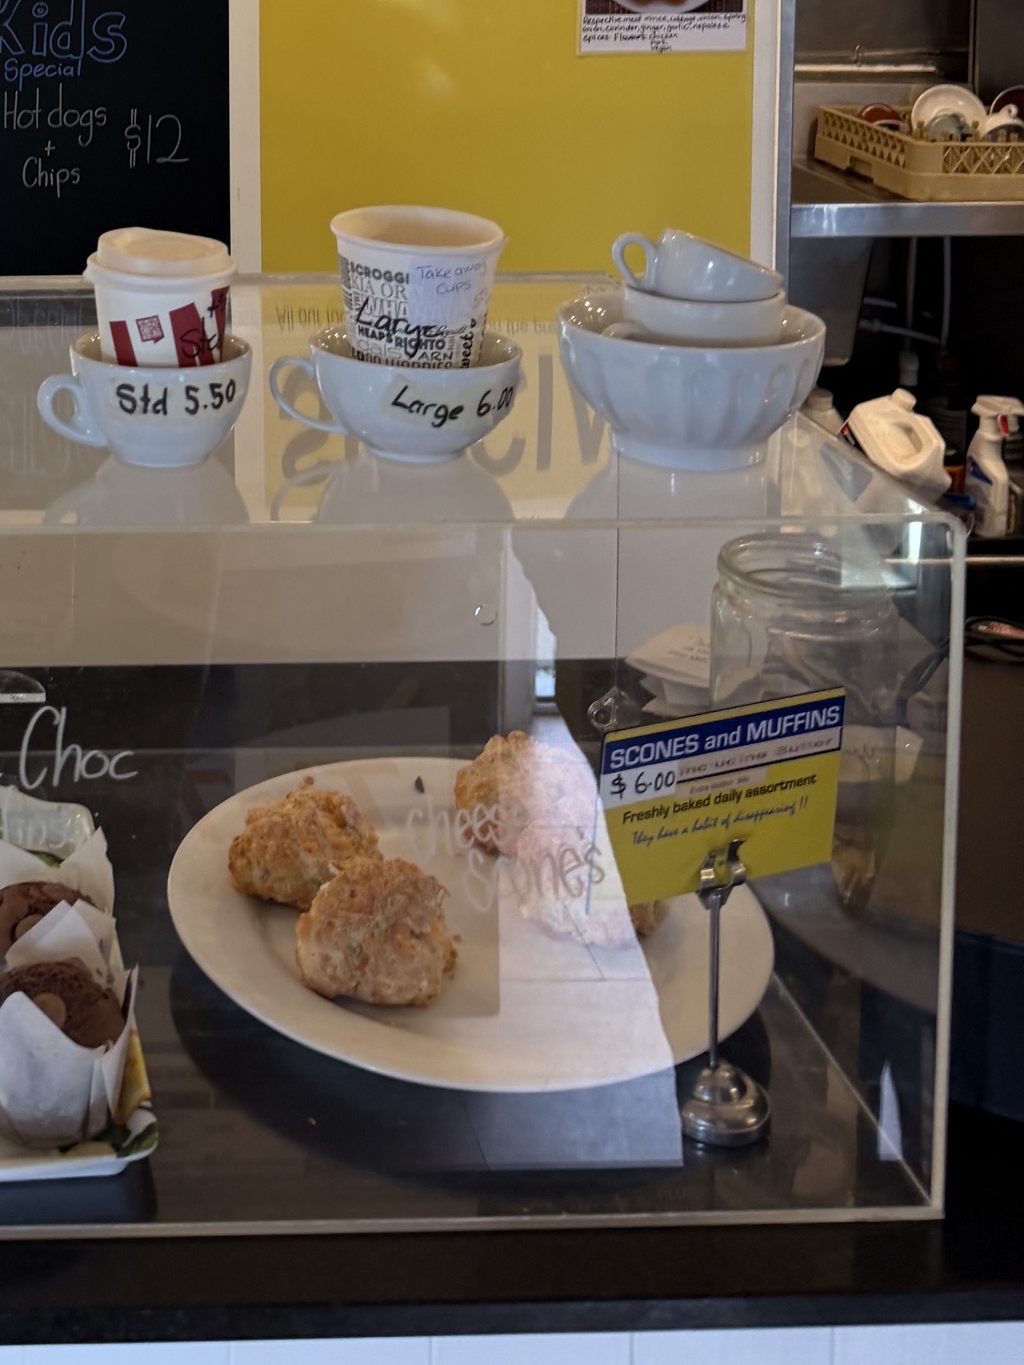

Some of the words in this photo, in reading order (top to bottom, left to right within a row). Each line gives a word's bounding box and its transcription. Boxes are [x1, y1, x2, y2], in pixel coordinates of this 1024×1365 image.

[4, 58, 82, 91] Special
[4, 88, 42, 130] Hot
[47, 83, 107, 146] dogs
[125, 109, 190, 168] $12
[23, 157, 80, 198] Chips
[115, 383, 168, 416] Std
[184, 379, 236, 414] 5.50
[391, 386, 464, 428] Large
[476, 386, 513, 416] 6.00
[19, 705, 137, 789] Choc
[610, 734, 699, 768] SCONES
[704, 725, 740, 751] and
[746, 706, 840, 742] MUFFINS
[623, 804, 670, 824] Freshly
[673, 794, 710, 813] baked
[714, 790, 741, 808] daily
[745, 774, 817, 798] assortment
[635, 770, 675, 794] 6.00
